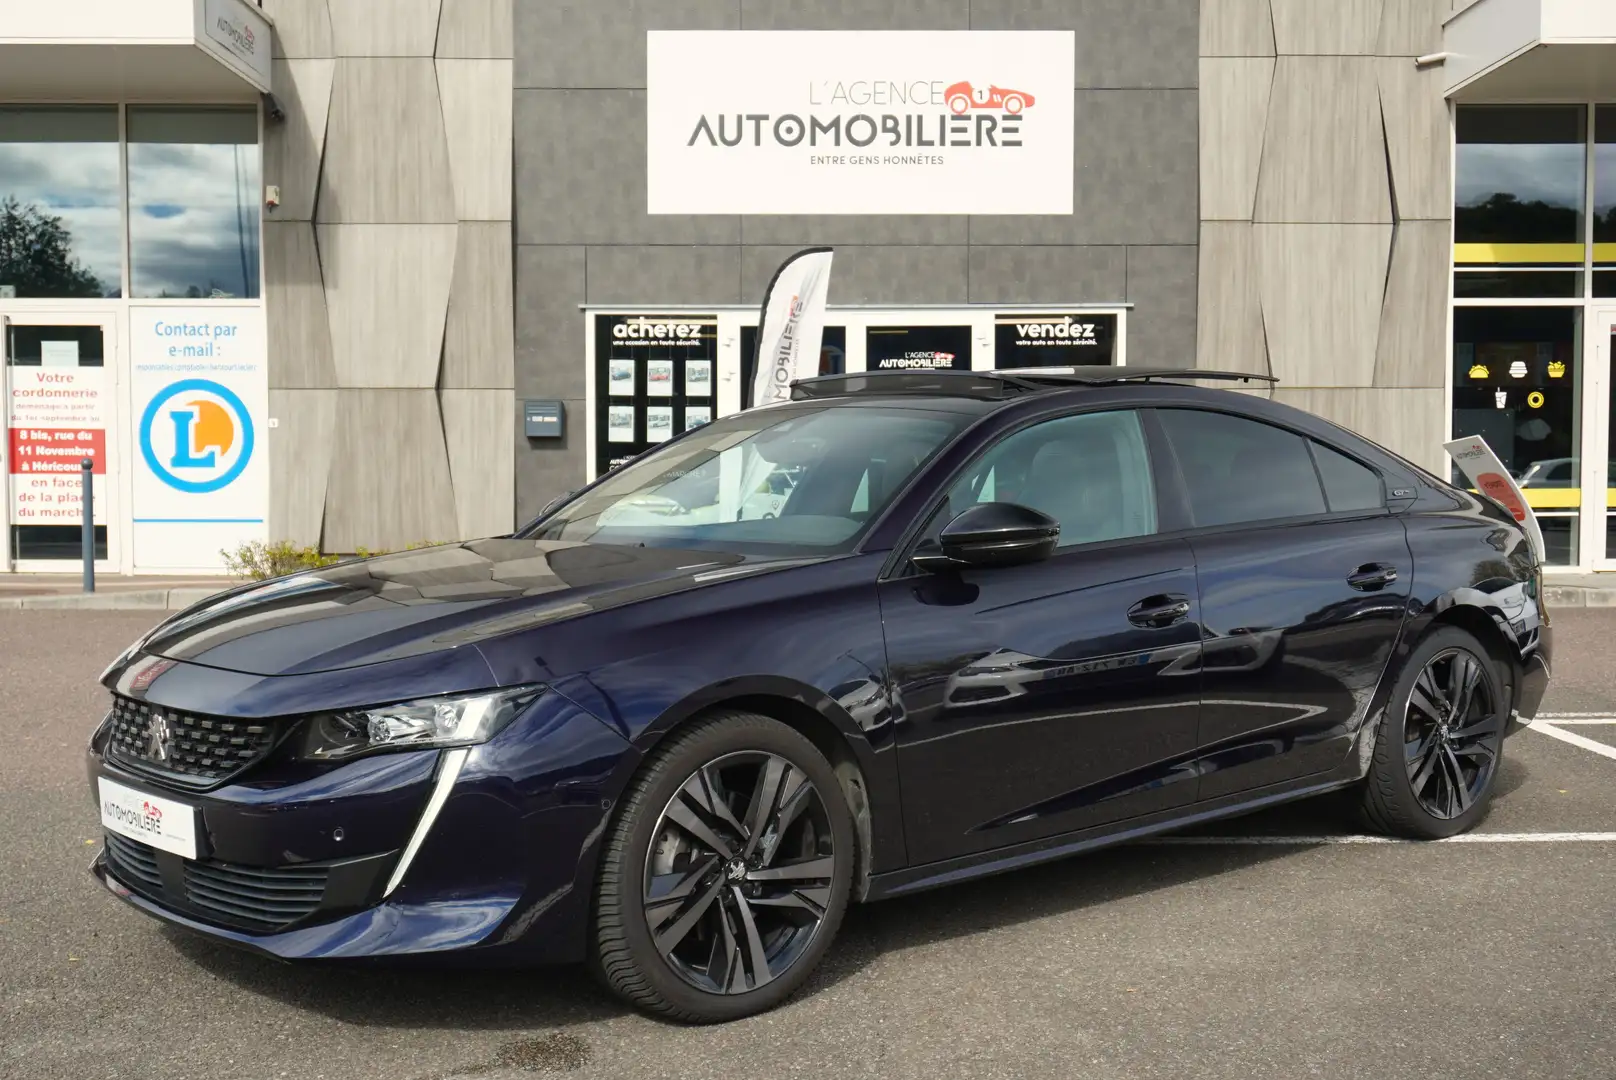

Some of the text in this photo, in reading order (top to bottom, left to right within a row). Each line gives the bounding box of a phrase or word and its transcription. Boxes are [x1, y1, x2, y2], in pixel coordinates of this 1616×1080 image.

[809, 80, 945, 105] L'AGENCE
[810, 152, 944, 165] ENTRE GENS HONNÊTES
[154, 321, 238, 340] Contact par
[612, 315, 702, 338] achetez
[1015, 316, 1096, 338] vendez
[168, 342, 214, 357] e-mail
[904, 351, 935, 359] L'AGENCE
[36, 372, 75, 383] Votre
[12, 387, 98, 398] cordonnerie
[19, 430, 93, 442] 8 bis, rue du
[18, 445, 96, 456] 11 Novembre
[32, 461, 83, 471] Héricour
[31, 477, 83, 488] en face
[18, 493, 36, 502] de
[40, 492, 53, 502] la
[18, 508, 35, 517] du
